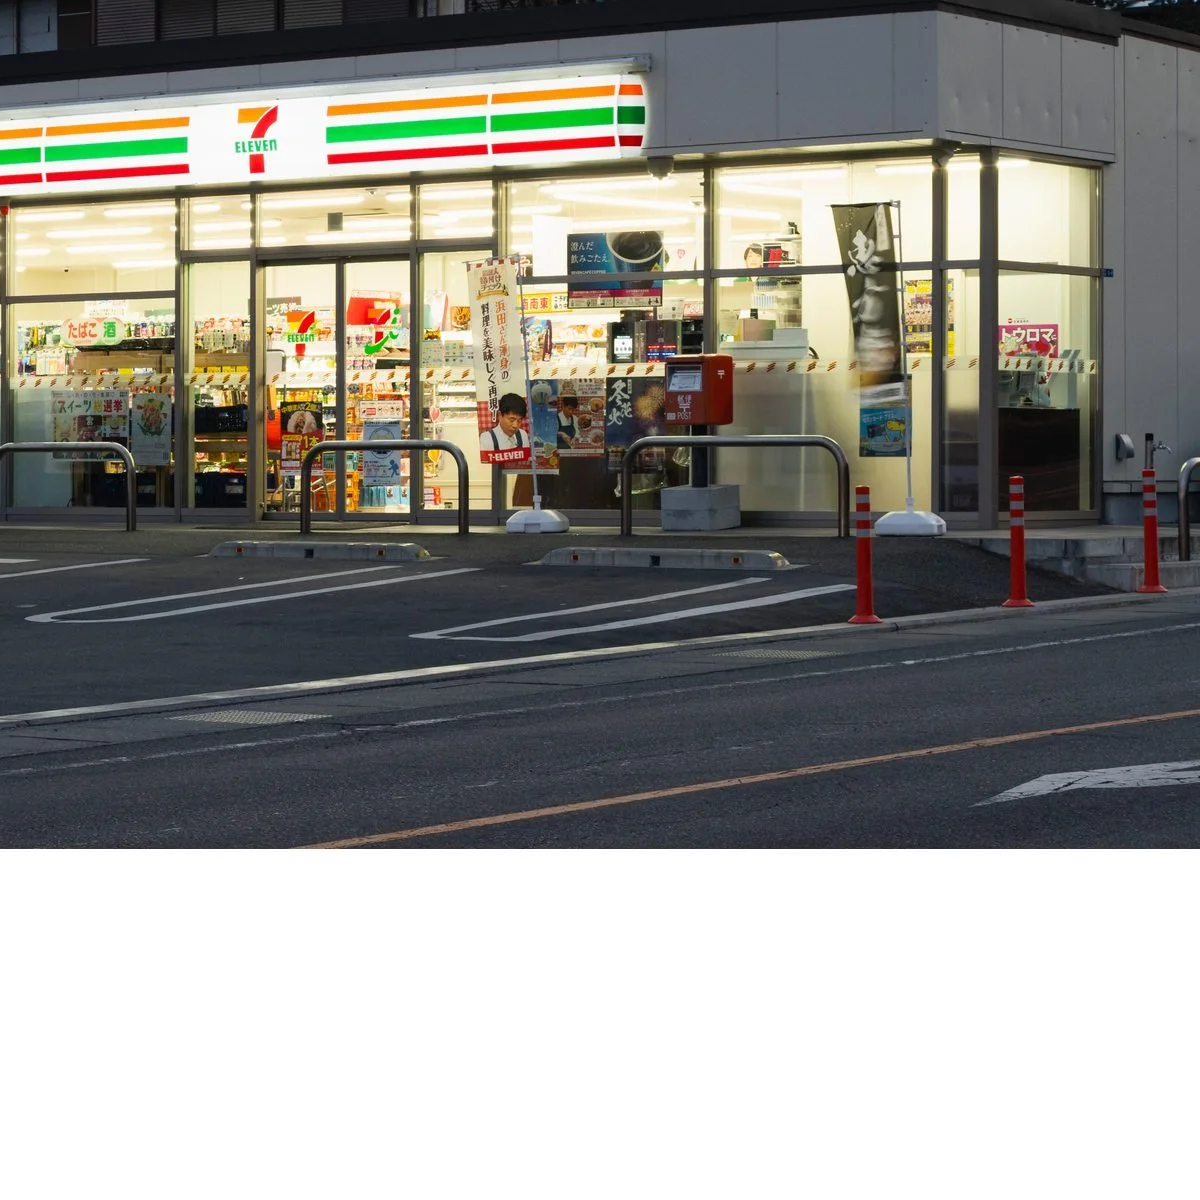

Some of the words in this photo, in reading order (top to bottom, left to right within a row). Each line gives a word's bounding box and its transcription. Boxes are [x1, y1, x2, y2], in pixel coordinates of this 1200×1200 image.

[238, 105, 278, 173] 7
[68, 321, 98, 338] たばこ
[103, 321, 117, 338] 酒
[677, 412, 692, 420] POST
